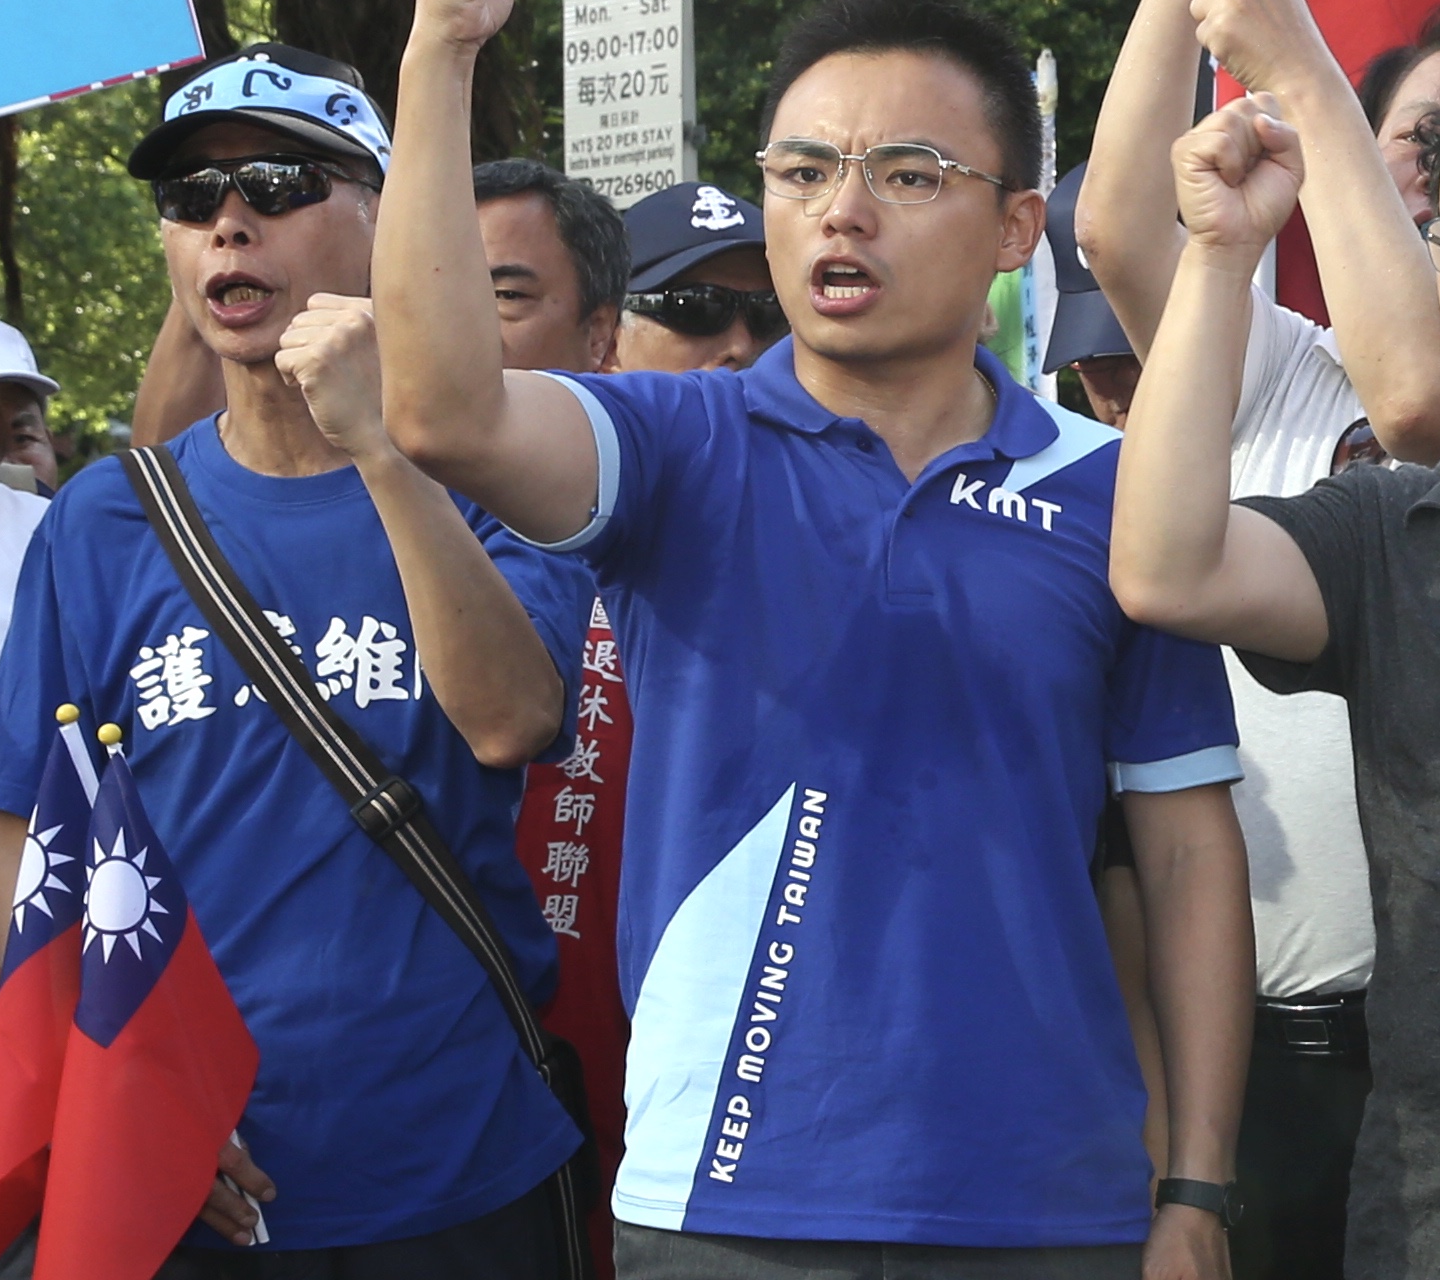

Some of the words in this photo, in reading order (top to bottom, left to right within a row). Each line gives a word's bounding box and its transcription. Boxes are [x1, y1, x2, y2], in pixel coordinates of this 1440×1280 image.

[575, 4, 612, 25] Mon.
[567, 25, 679, 65] 09:00-17:00
[578, 63, 669, 106] 每次20元
[597, 134, 612, 151] 20
[616, 131, 638, 149] PER
[642, 127, 673, 144] STAY
[949, 472, 1064, 533] KMT
[129, 608, 422, 731] 護維
[709, 1093, 753, 1185] KEEP
[736, 941, 795, 1083] MOVING
[776, 787, 828, 927] TAIWAN
